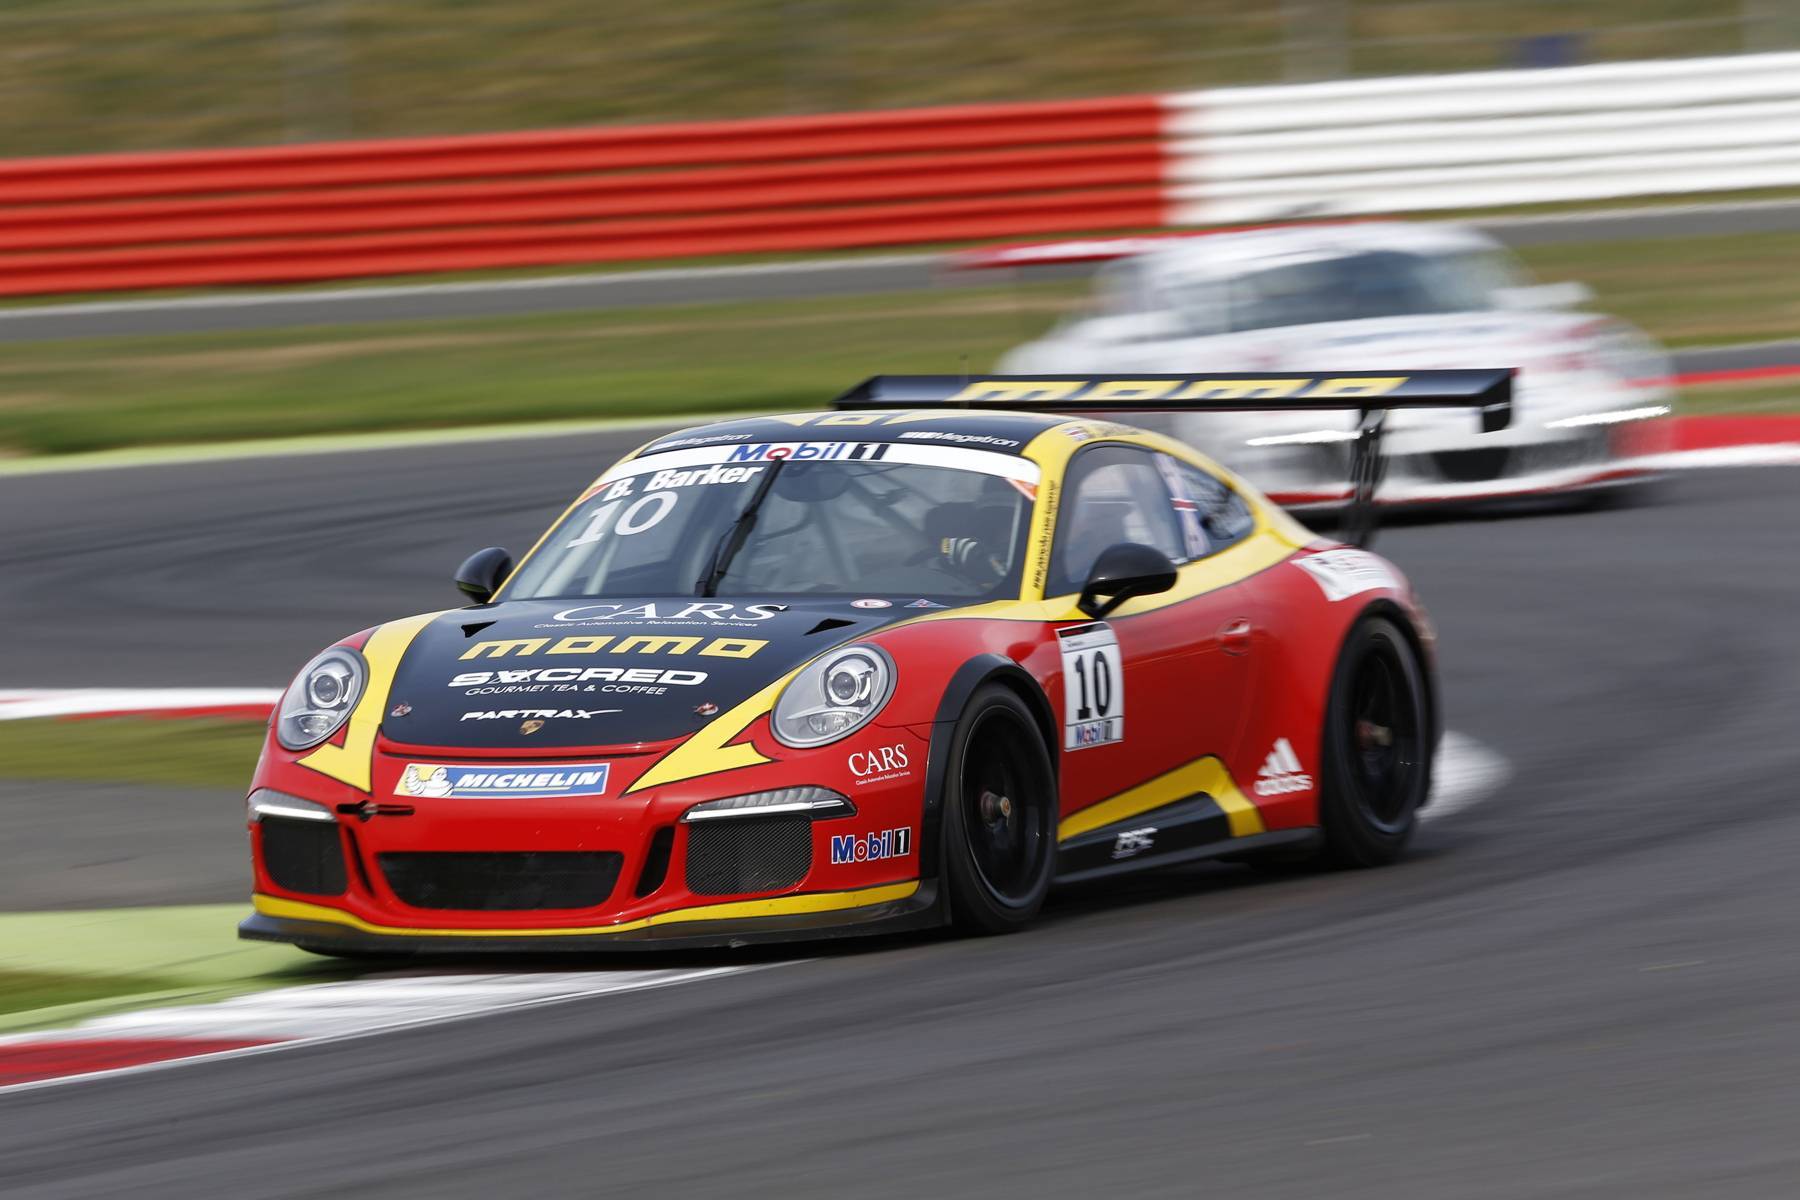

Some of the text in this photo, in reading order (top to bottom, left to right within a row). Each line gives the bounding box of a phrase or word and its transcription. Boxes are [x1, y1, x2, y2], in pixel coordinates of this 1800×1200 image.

[727, 443, 846, 463] Mobil
[602, 464, 765, 502] B. Barker
[566, 491, 679, 549] 10
[553, 602, 788, 621] CARS
[711, 620, 758, 628] Services
[465, 683, 668, 696] GOURMET TEA & COFFEE
[1074, 650, 1112, 720] 10
[460, 709, 623, 721] PARTRAX
[848, 743, 909, 777] CARS
[456, 771, 604, 788] MICHELIN
[831, 829, 893, 865] Mobil
